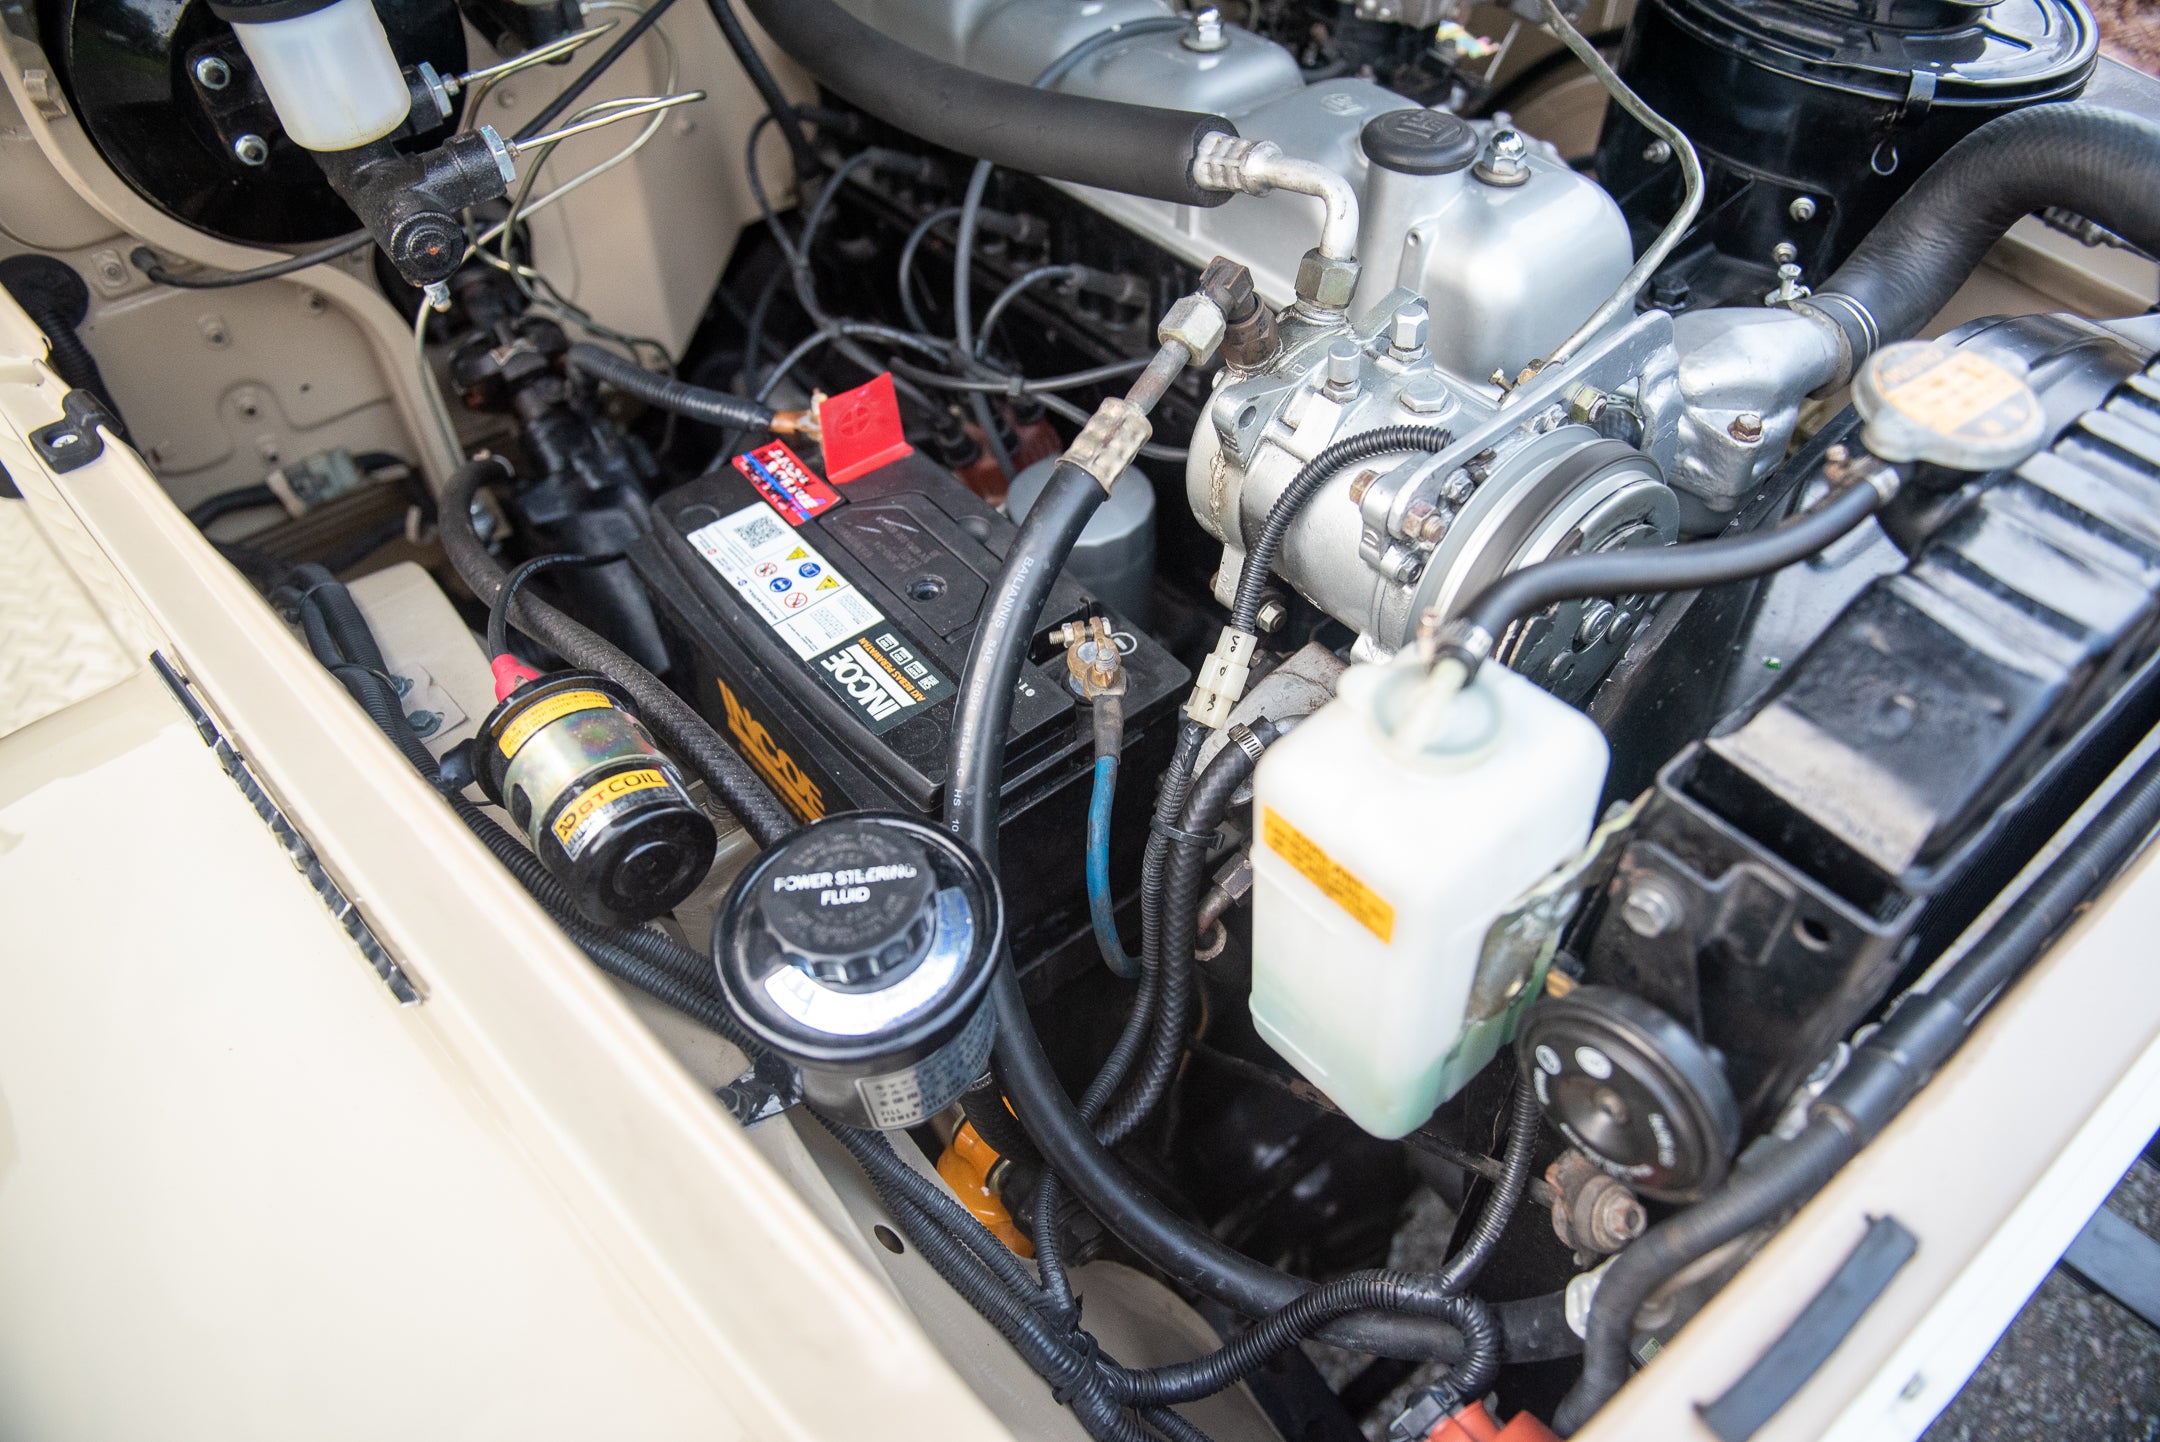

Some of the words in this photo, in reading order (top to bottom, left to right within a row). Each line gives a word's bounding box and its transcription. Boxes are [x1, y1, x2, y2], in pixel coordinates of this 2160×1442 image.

[995, 556, 1034, 629] BAILIANNIS
[857, 637, 896, 674] PERAWATAN
[983, 639, 998, 664] SAE
[820, 649, 901, 721] INCOE
[891, 670, 915, 692] BEBAS
[911, 690, 926, 702] AKI
[952, 789, 962, 806] HS
[951, 819, 960, 833] 10
[773, 872, 833, 892] POWER
[834, 863, 918, 886] STEERING
[820, 886, 871, 906] FLUID
